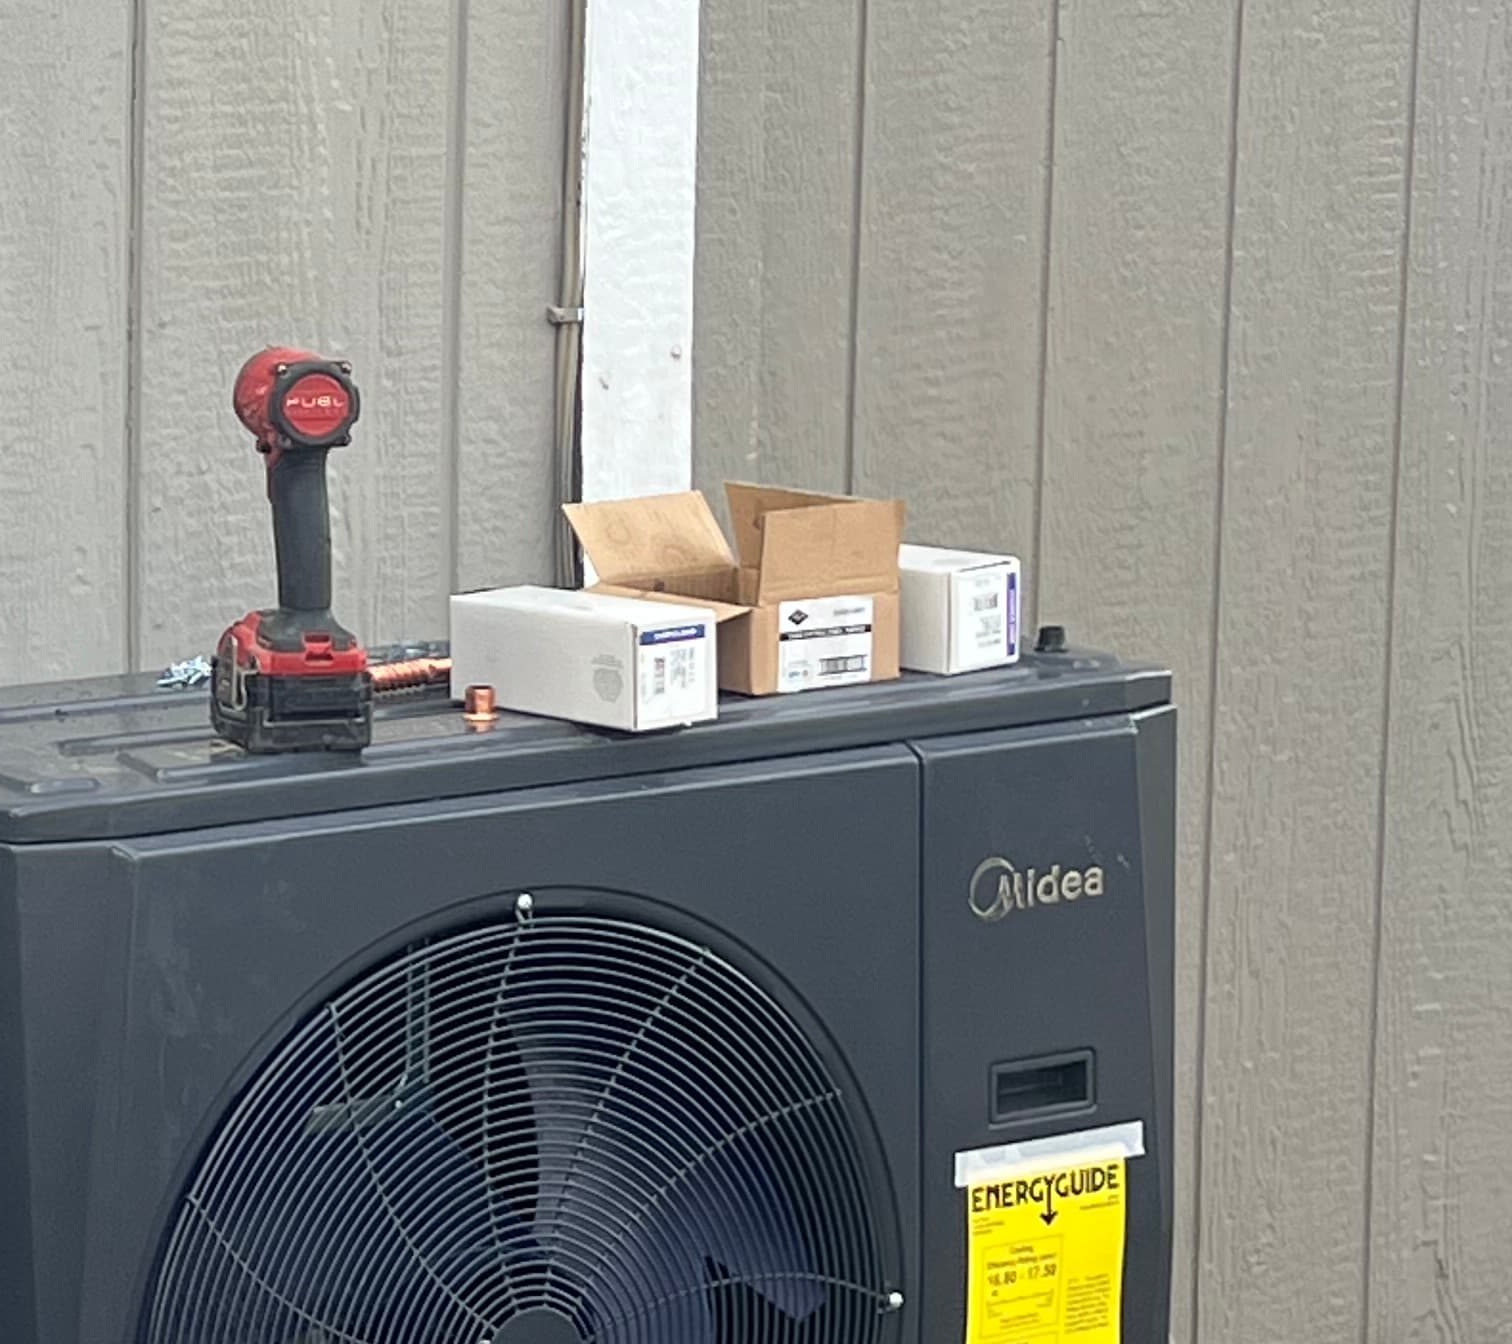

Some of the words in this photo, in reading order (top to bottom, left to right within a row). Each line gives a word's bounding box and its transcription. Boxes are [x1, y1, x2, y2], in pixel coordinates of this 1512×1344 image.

[285, 395, 345, 407] FUEL
[968, 856, 1104, 923] Midea
[971, 1164, 1120, 1215] ENERGYGUIDE
